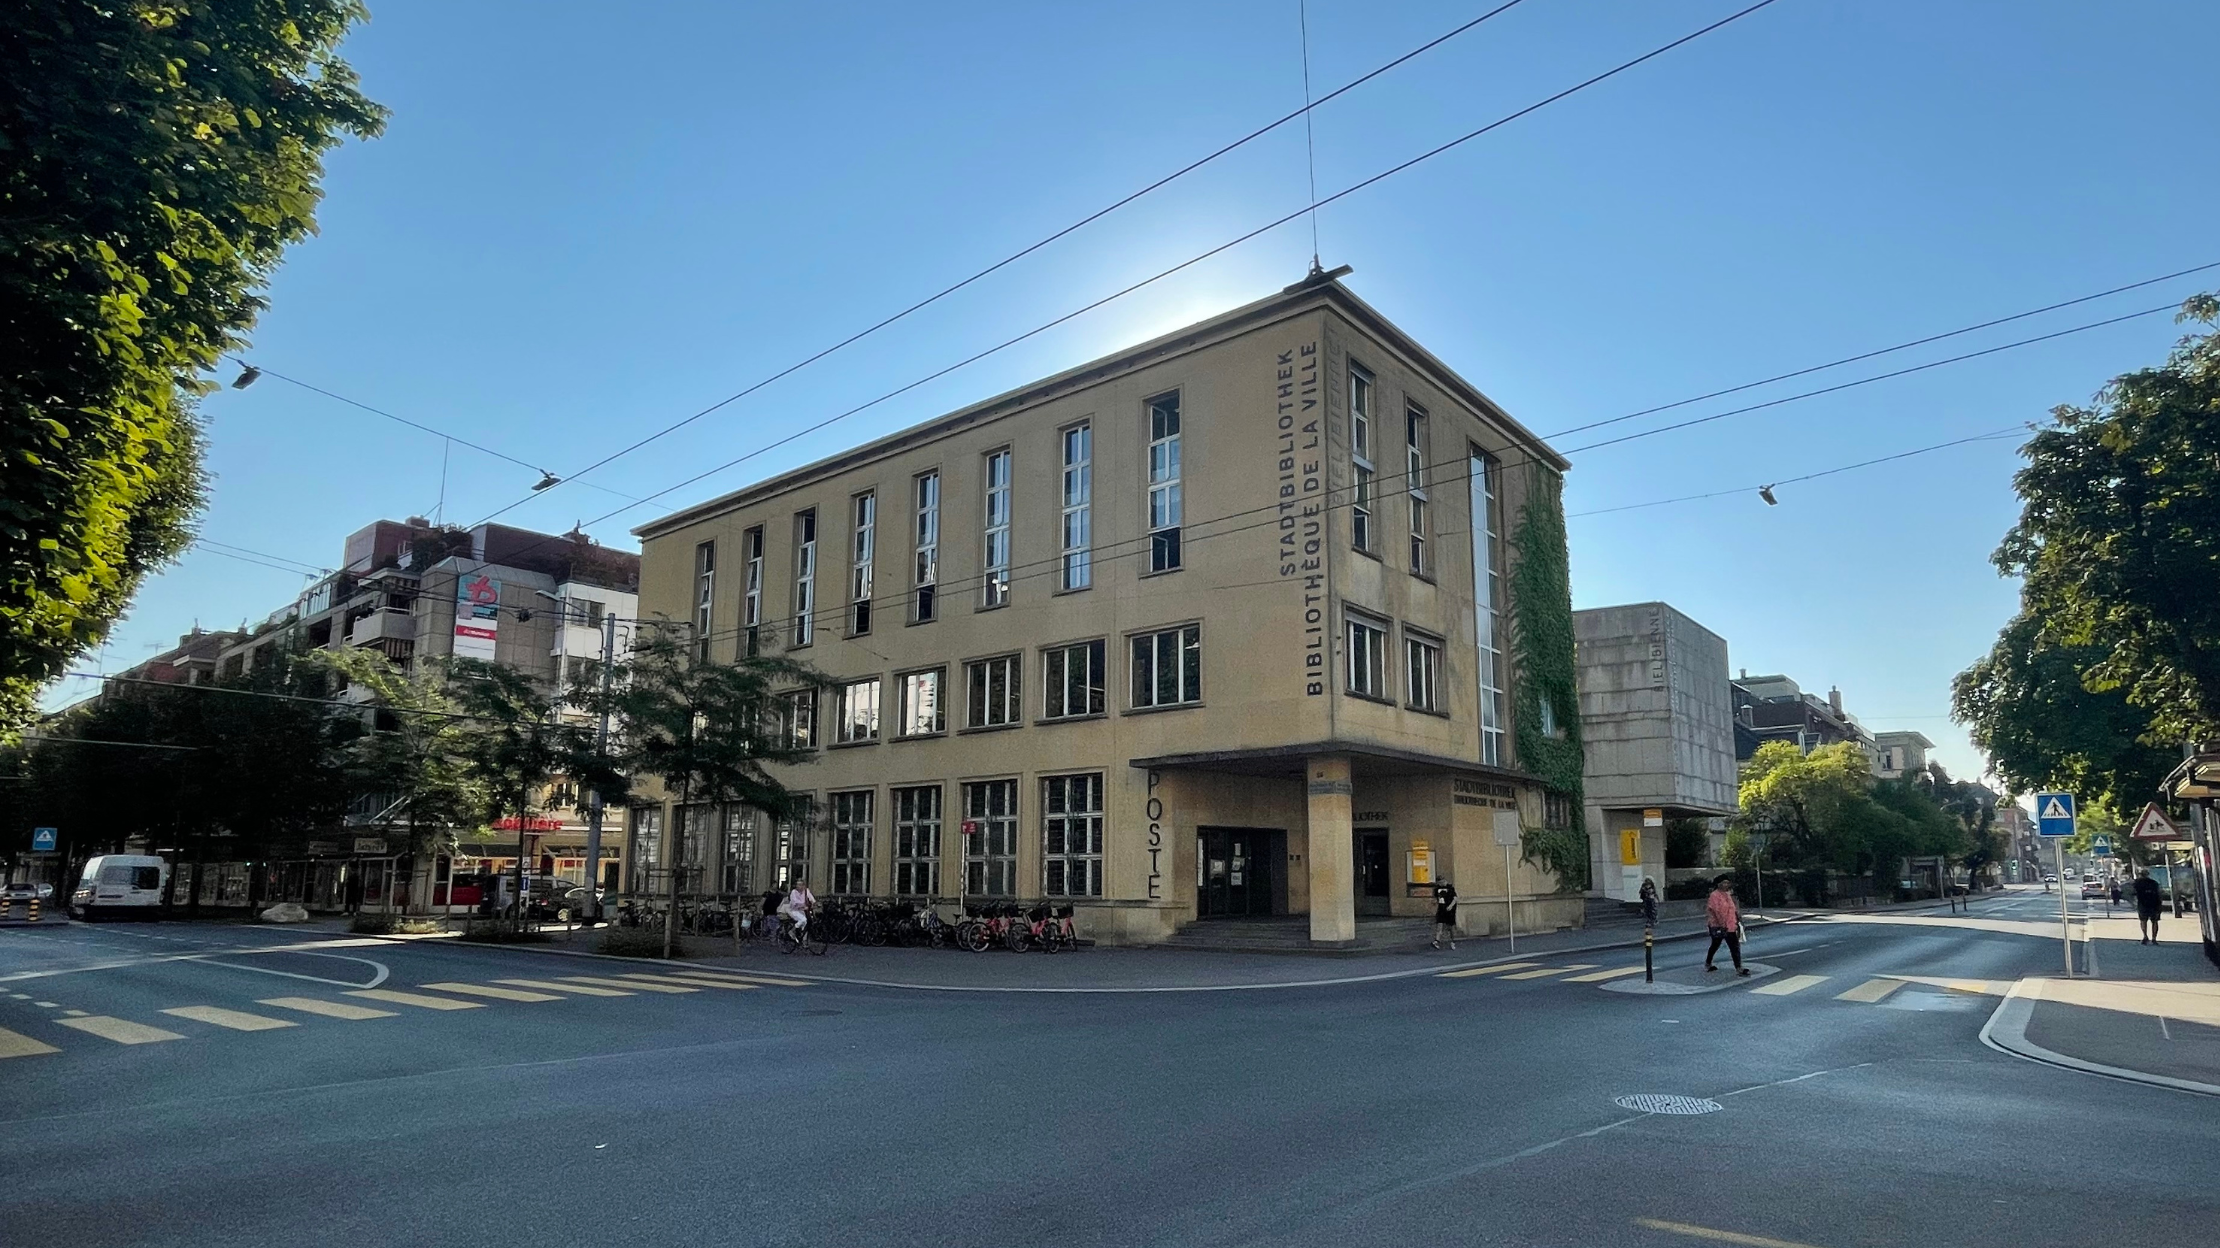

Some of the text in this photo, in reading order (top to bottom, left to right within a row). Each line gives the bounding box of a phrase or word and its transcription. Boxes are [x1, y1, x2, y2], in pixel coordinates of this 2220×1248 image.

[1278, 349, 1296, 577] STADTBIBLIOTHEK
[1301, 341, 1323, 696] BIBLIOTHÈQUE DE LA VILLE
[1147, 769, 1163, 899] POSTE
